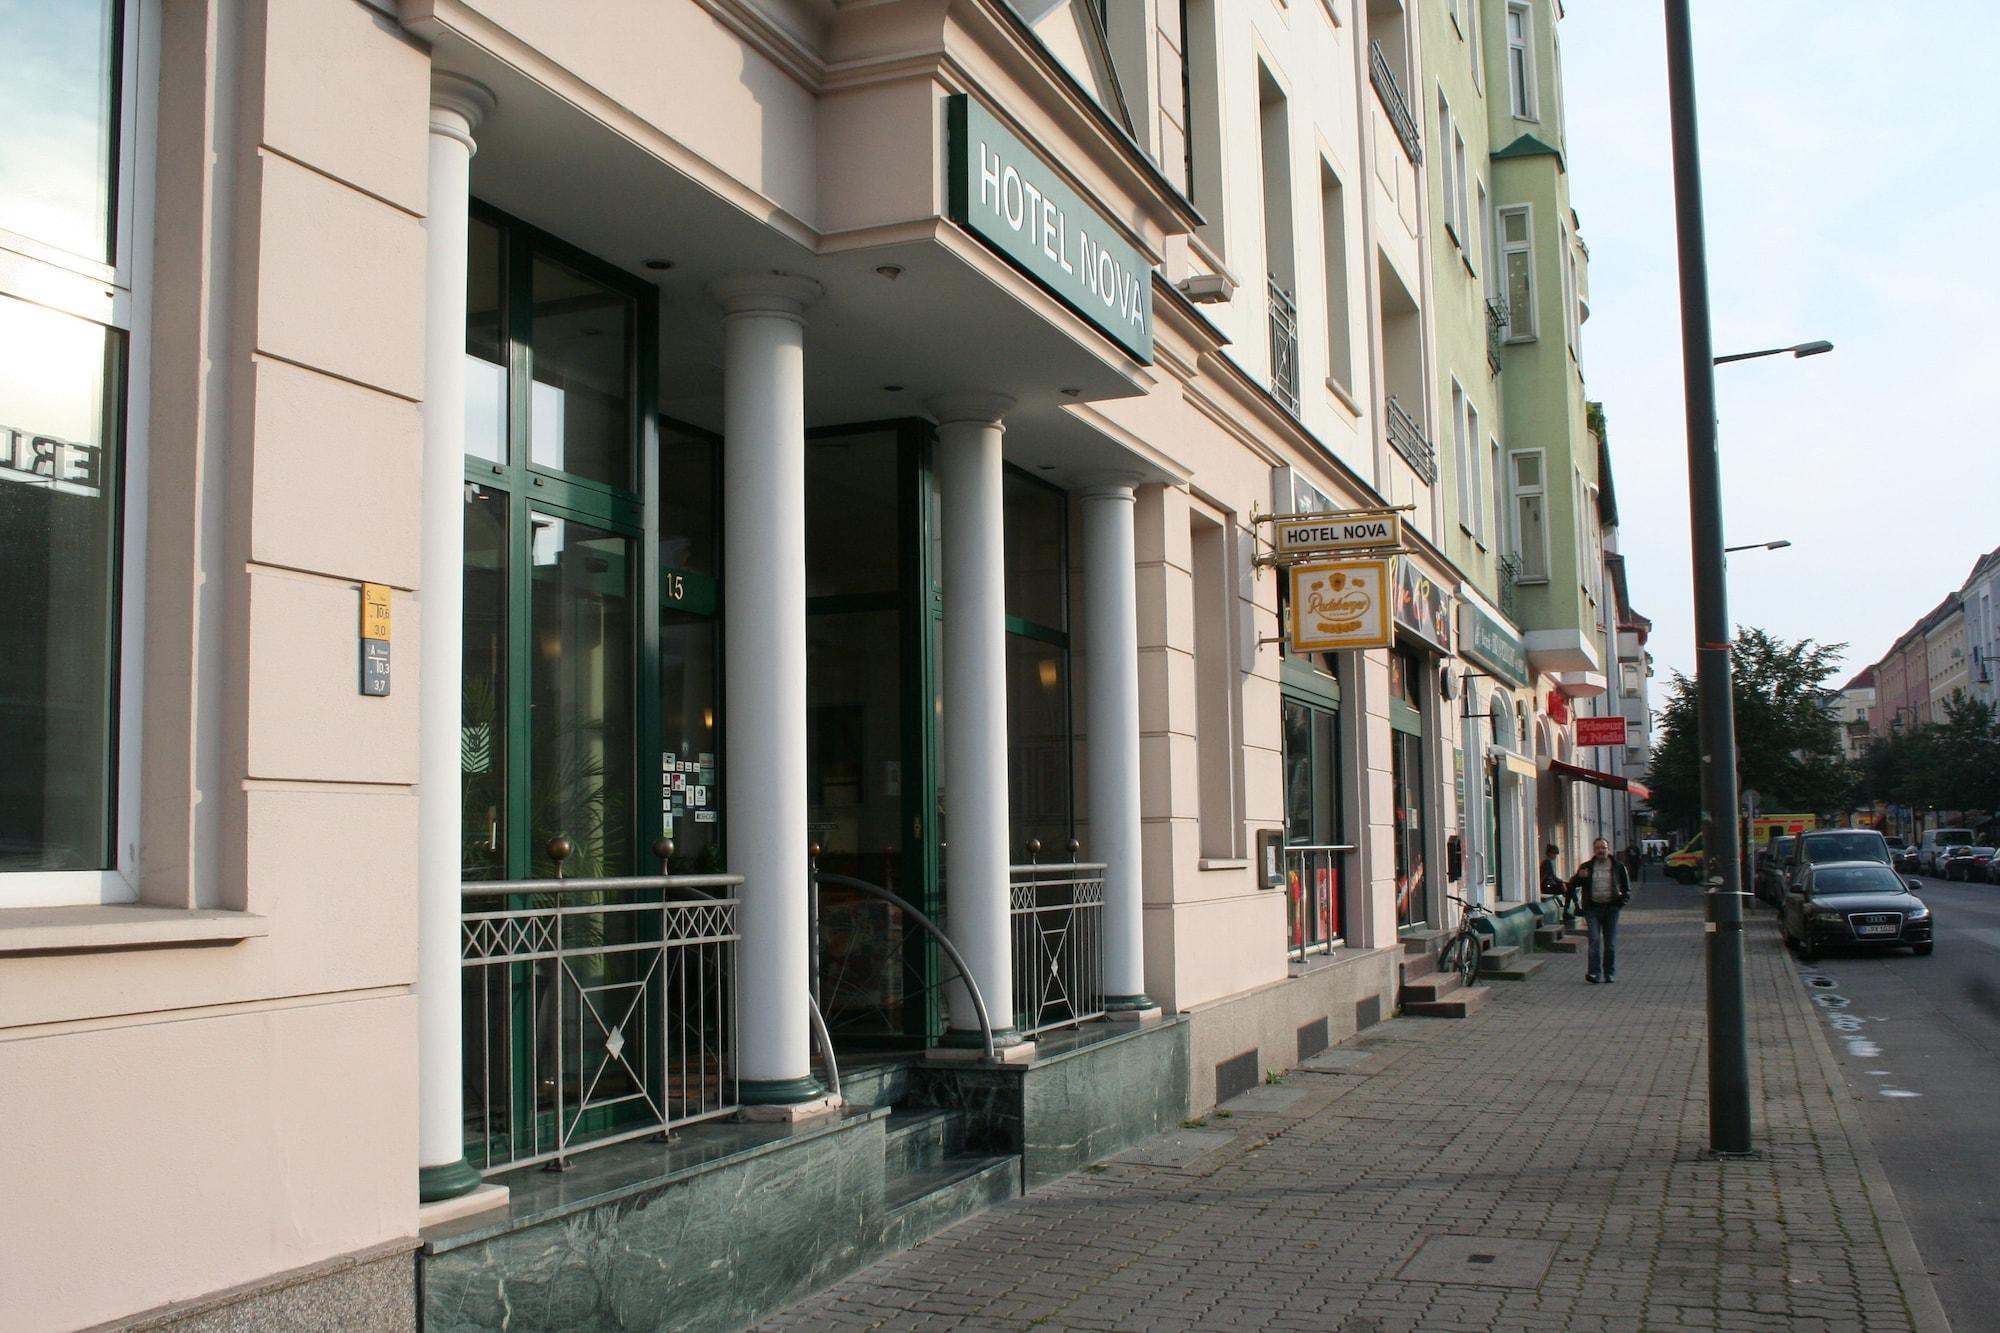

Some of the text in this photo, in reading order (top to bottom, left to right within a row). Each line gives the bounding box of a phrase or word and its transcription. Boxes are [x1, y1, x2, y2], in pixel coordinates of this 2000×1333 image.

[980, 141, 1146, 335] HOTEL NOVA
[1287, 522, 1387, 544] HOTEL NOVA
[667, 573, 684, 600] 15
